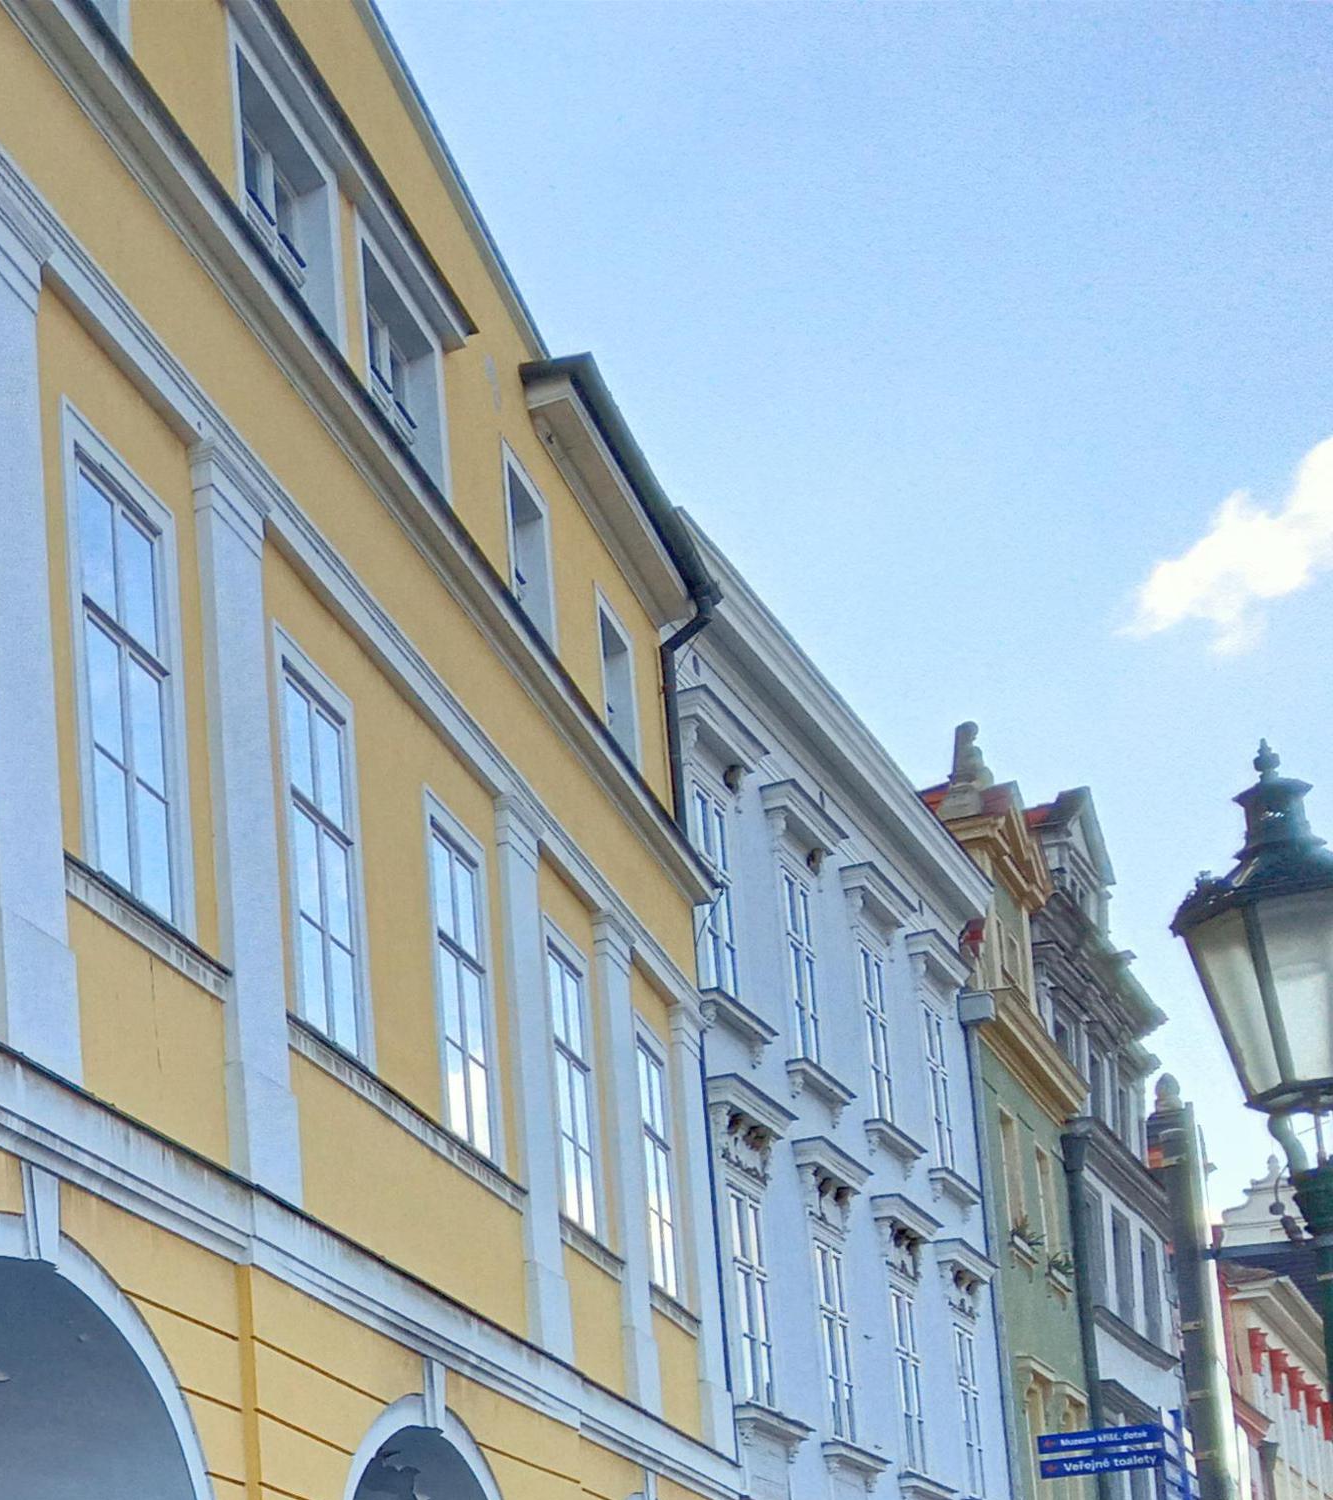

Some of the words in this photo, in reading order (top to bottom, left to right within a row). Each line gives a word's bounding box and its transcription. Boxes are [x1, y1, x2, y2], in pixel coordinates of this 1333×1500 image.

[1060, 1436, 1096, 1447] Muzeum
[1063, 1457, 1110, 1472] Veřejné
[1113, 1454, 1157, 1468] toalety
